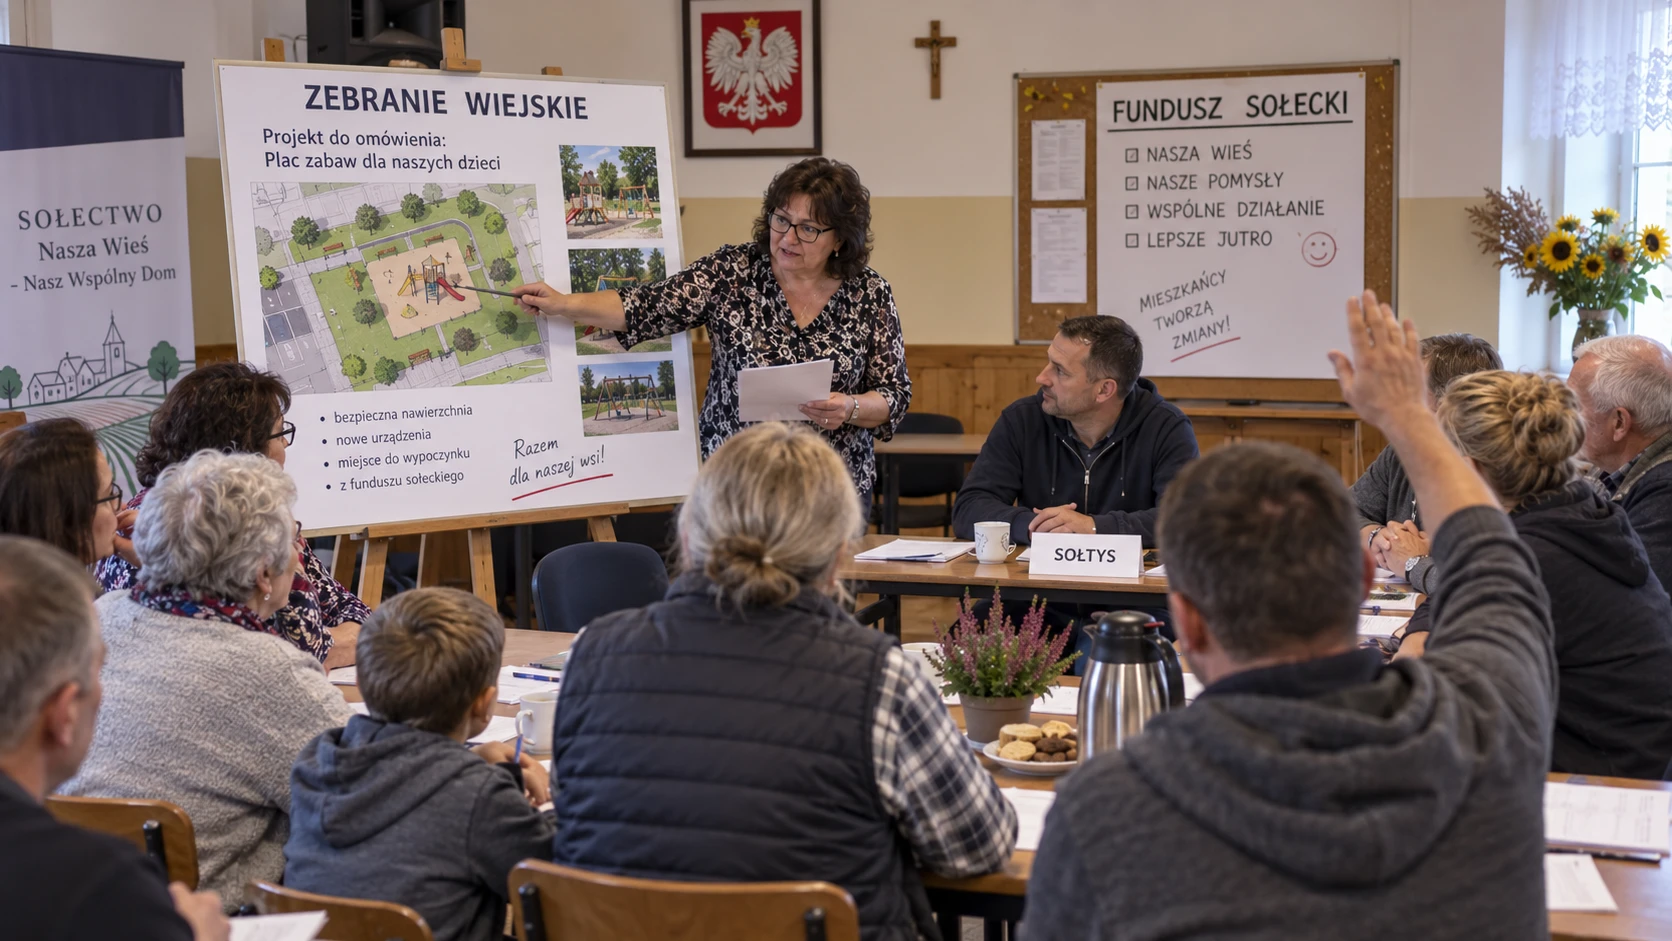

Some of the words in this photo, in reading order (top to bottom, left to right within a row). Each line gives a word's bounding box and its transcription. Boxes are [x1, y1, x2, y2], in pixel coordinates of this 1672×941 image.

[304, 84, 448, 115] ZEBRANIE
[465, 90, 589, 120] WIEJSKIE
[1112, 96, 1223, 123] FUNDUSZ
[1245, 90, 1349, 119] SOŁECKI
[262, 128, 324, 149] Projekt
[329, 129, 350, 145] do
[355, 130, 447, 148] omówienia:
[265, 151, 300, 168] Plac
[305, 152, 357, 169] zabaw
[362, 153, 386, 169] dla
[392, 154, 453, 174] naszych
[458, 155, 501, 170] dzieci
[1146, 146, 1200, 163] NASZA
[1211, 139, 1253, 161] WIEŚ
[1146, 175, 1198, 190] NASZE
[1208, 172, 1284, 189] POMYSŁY
[18, 203, 162, 231] SOŁECTWO
[1147, 198, 1225, 219] WSPÓLNE
[1237, 200, 1325, 217] DZIAŁANIE
[38, 241, 97, 261] Nasza
[102, 235, 149, 256] Wieś
[1147, 231, 1206, 248] LEPSZE
[1217, 230, 1273, 247] JUTRO
[23, 274, 64, 292] Nasz
[67, 268, 137, 290] Wspólny
[141, 265, 177, 282] Dom
[1139, 269, 1227, 313] MIESZKAŃCY
[1153, 300, 1215, 331] TWORZĄ
[1172, 315, 1231, 350] ZMIANY!
[334, 409, 398, 425] bezpieczna
[401, 404, 473, 420] nawierzchnia
[336, 433, 368, 446] nowe
[371, 429, 432, 445] urządzenia
[514, 438, 559, 459] Razem
[338, 454, 382, 472] miejsce
[384, 451, 400, 465] do
[403, 447, 470, 466] wypoczynku
[509, 467, 530, 486] dla
[535, 456, 575, 480] naszej
[580, 444, 605, 469] wsi!
[340, 481, 347, 491] z
[350, 474, 402, 490] funduszu
[406, 470, 465, 488] sołeckiego
[1054, 547, 1116, 563] SOŁTYS
